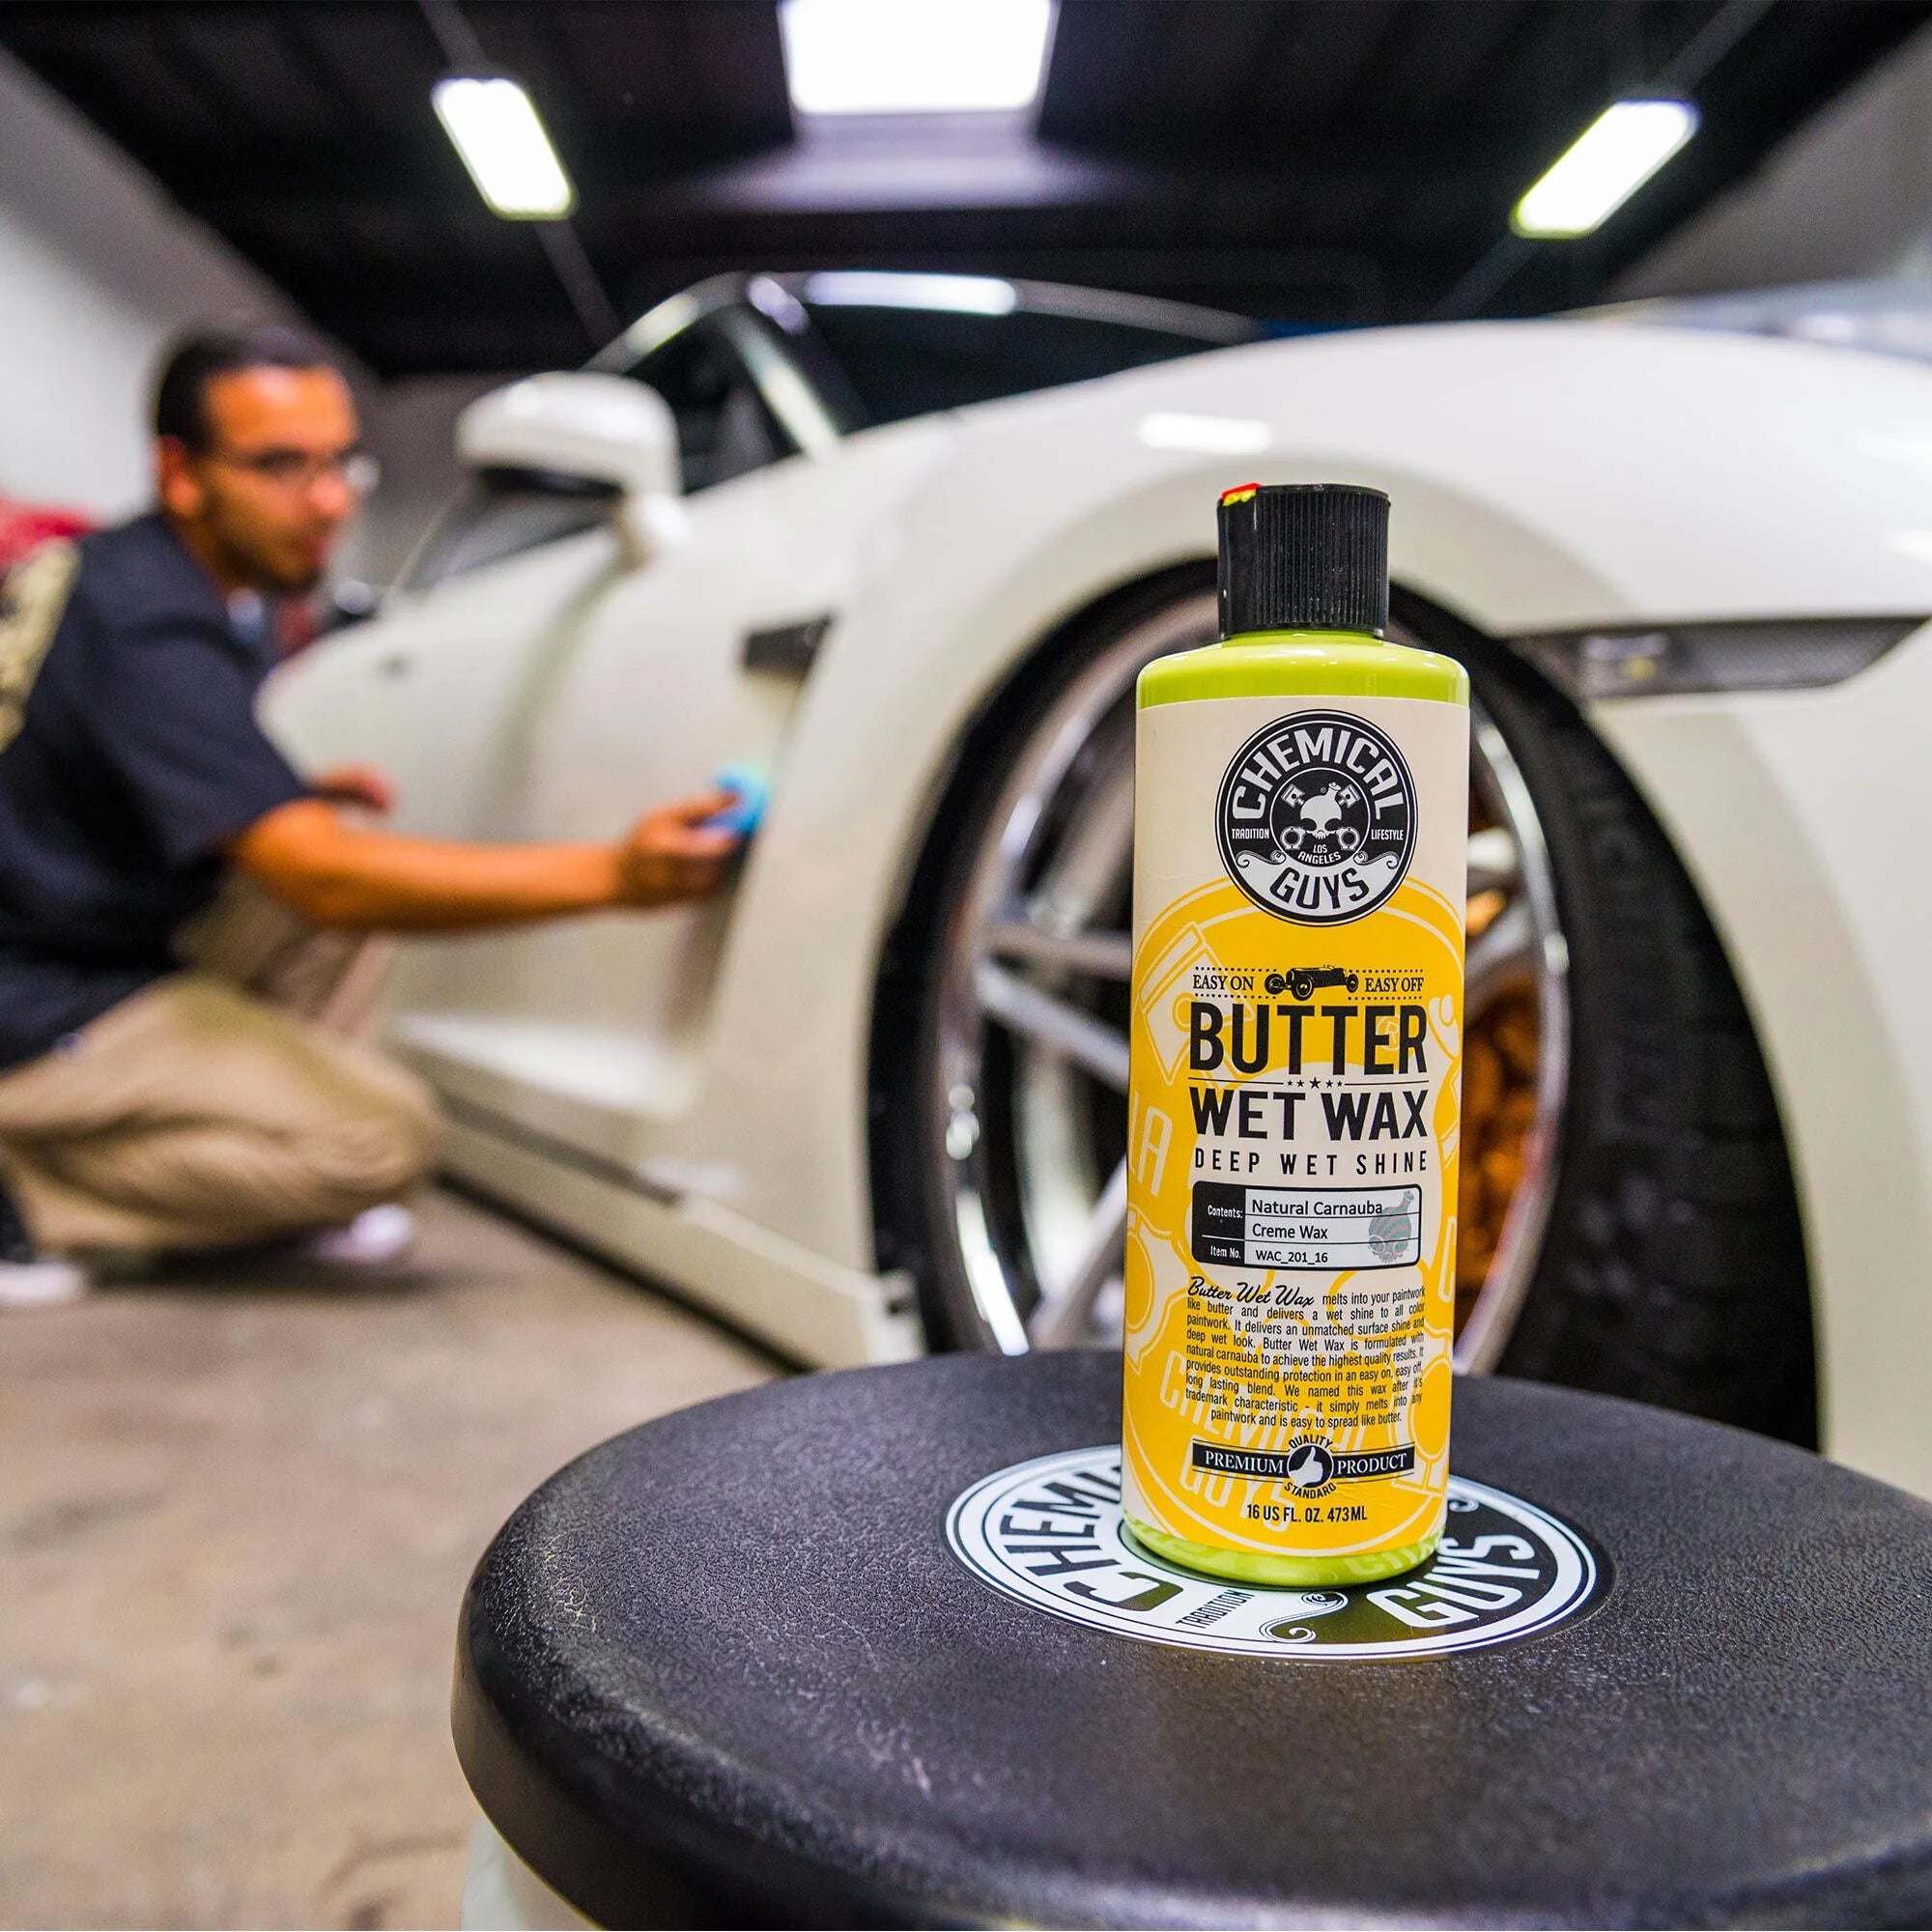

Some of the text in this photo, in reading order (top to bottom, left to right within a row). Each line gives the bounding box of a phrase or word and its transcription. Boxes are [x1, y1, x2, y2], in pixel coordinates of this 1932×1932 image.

[1232, 727, 1405, 820] CHEMICAL
[1232, 828, 1405, 841] TRADITION LIFESTYLE
[1297, 851, 1342, 865] ANGELES
[1313, 844, 1328, 854] LOS
[1269, 867, 1370, 910] GUYS
[1192, 974, 1425, 993] EASY ON EASY OFF
[1189, 1001, 1429, 1076] BUTTER
[1189, 1086, 1430, 1142] WET WAX
[1194, 1148, 1428, 1176] DEEP WET SHINE
[1208, 1204, 1244, 1219] Contents:
[1252, 1200, 1383, 1216] Natural Carnauba
[1252, 1223, 1328, 1240] Creme Wax
[1209, 1245, 1241, 1260] Item No.
[1255, 1250, 1328, 1264] WAC_201_16
[1187, 1276, 1425, 1308] Butter Wet Wax melts into your paintwork
[1187, 1297, 1425, 1321] like butter and delivers a wet shine to all color
[1187, 1314, 1425, 1336] paintwork. It delivers an unmatched surface shine and
[1186, 1328, 1424, 1351] deep wet look. Butter Wet Wax is formulated with
[1186, 1344, 1213, 1358] natural
[1216, 1350, 1259, 1364] carnauba
[1261, 1353, 1270, 1365] to
[1272, 1353, 1309, 1366] achieve
[1312, 1354, 1326, 1367] the
[1329, 1353, 1362, 1369] highest
[1364, 1351, 1391, 1367] quality
[1393, 1349, 1417, 1362] results.
[1186, 1359, 1221, 1375] provides
[1224, 1366, 1280, 1382] outstanding
[1283, 1370, 1331, 1383] protection
[1334, 1370, 1343, 1381] in
[1346, 1372, 1357, 1381] an
[1359, 1371, 1378, 1381] easy
[1380, 1368, 1393, 1379] on,
[1395, 1365, 1411, 1378] easy
[1186, 1372, 1423, 1397] long lasting blend. We named this wax after it's
[1185, 1388, 1228, 1406] trademark
[1234, 1396, 1298, 1411] characteristic
[1317, 1401, 1322, 1412] it
[1329, 1400, 1359, 1414] simply
[1366, 1398, 1388, 1410] melts
[1393, 1395, 1407, 1407] into
[1410, 1392, 1422, 1405] any
[1211, 1409, 1402, 1430] paintwork and is easy to spread like butter.
[1288, 1434, 1335, 1450] QUALITY
[1205, 1450, 1407, 1475] PREMIUM PRODUCT
[1284, 1481, 1337, 1499] STANDARD
[1246, 1503, 1260, 1520] 16
[1263, 1505, 1280, 1521] US
[1283, 1506, 1301, 1523] FL.
[1304, 1506, 1324, 1523] OZ.
[1366, 1534, 1541, 1628] GUYS
